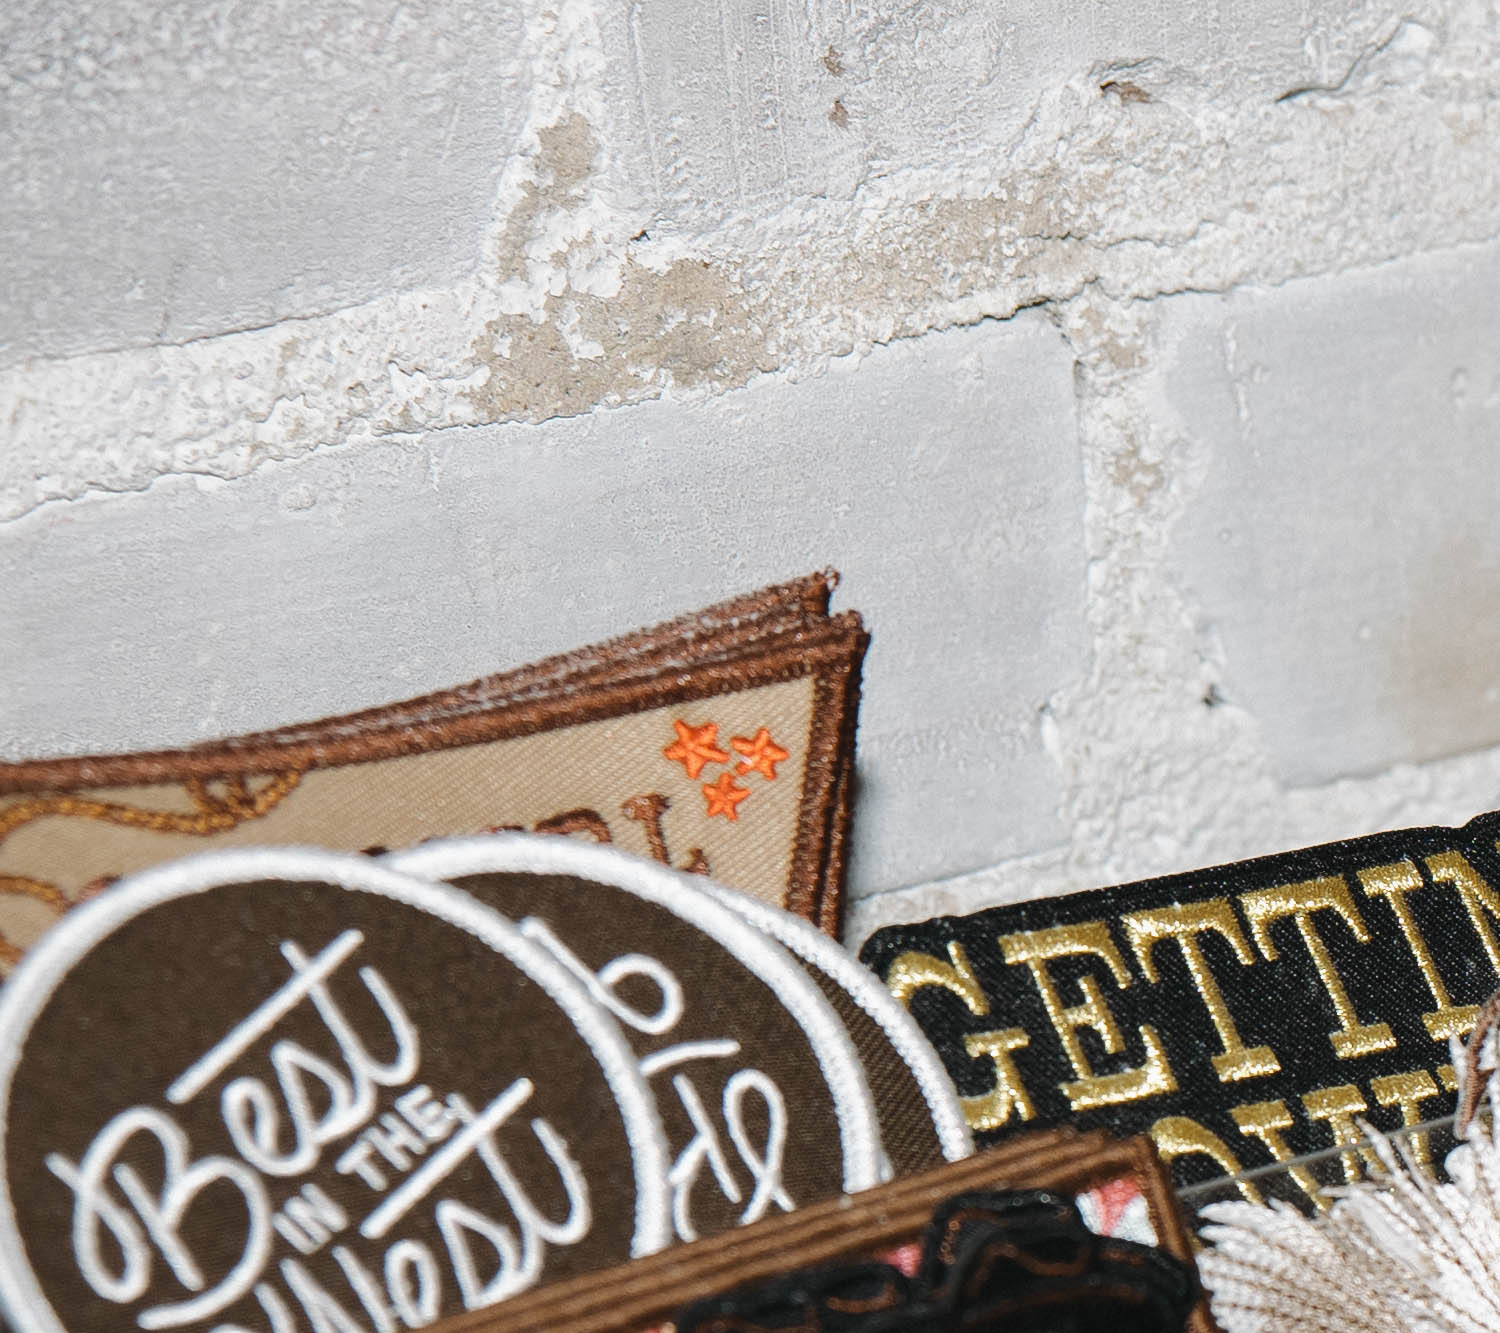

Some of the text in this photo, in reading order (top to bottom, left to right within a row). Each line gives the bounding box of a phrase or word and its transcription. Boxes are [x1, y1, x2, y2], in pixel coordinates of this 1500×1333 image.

[47, 928, 422, 1330] Best
[273, 1082, 455, 1256] IN THE
